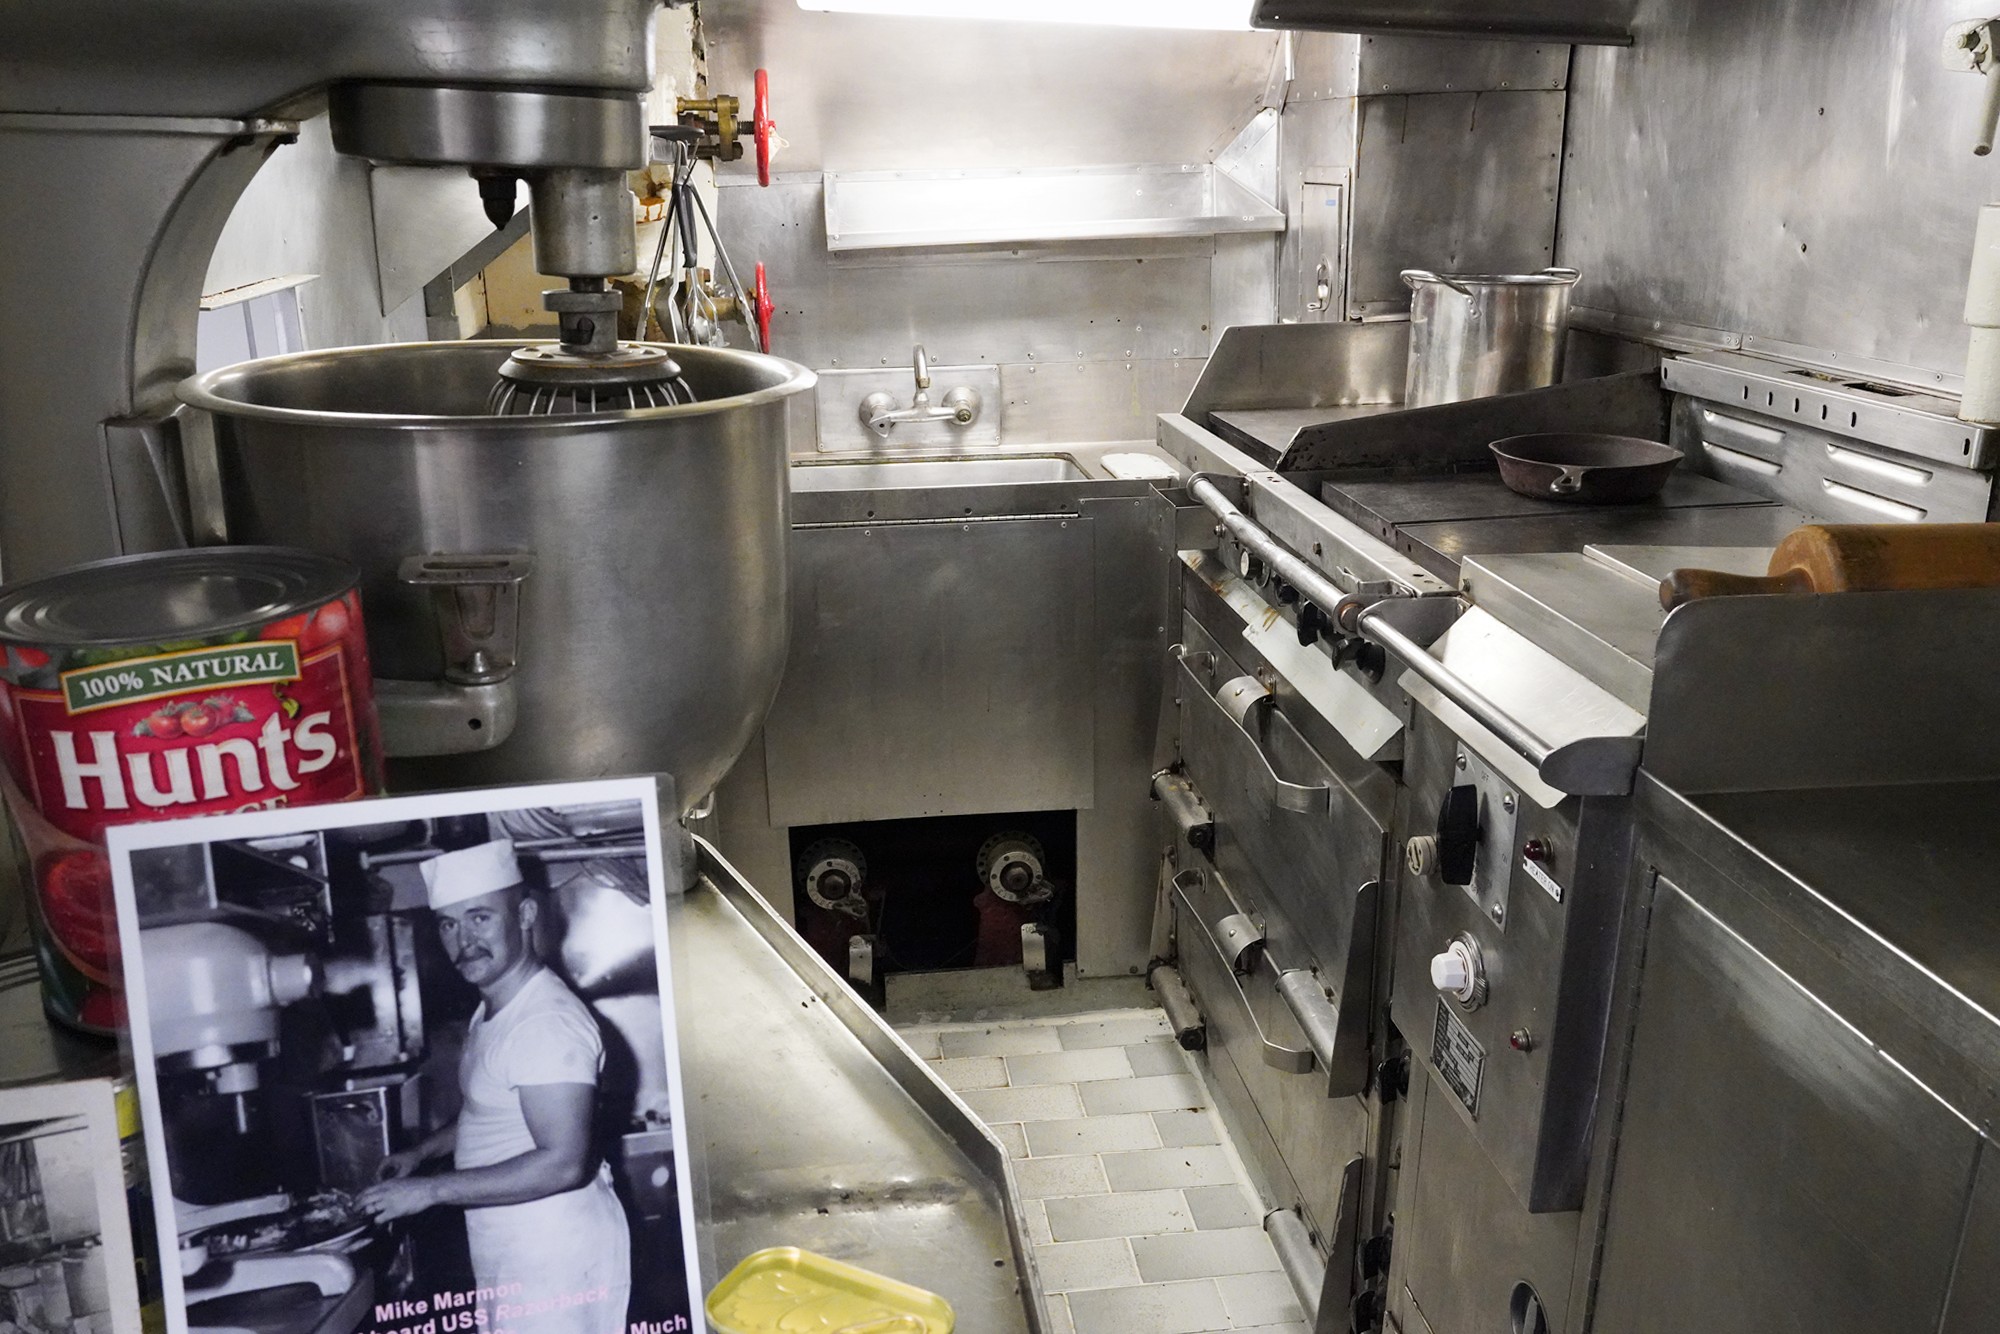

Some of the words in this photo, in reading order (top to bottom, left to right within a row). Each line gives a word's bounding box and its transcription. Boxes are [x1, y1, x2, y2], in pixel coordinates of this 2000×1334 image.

[80, 671, 144, 699] 100%
[150, 652, 284, 686] NATURAL
[375, 1300, 429, 1323] Mike
[433, 1281, 522, 1311] Marmon
[442, 1308, 488, 1332] USS
[496, 1283, 608, 1321] Razorback
[630, 1314, 688, 1334] Much
